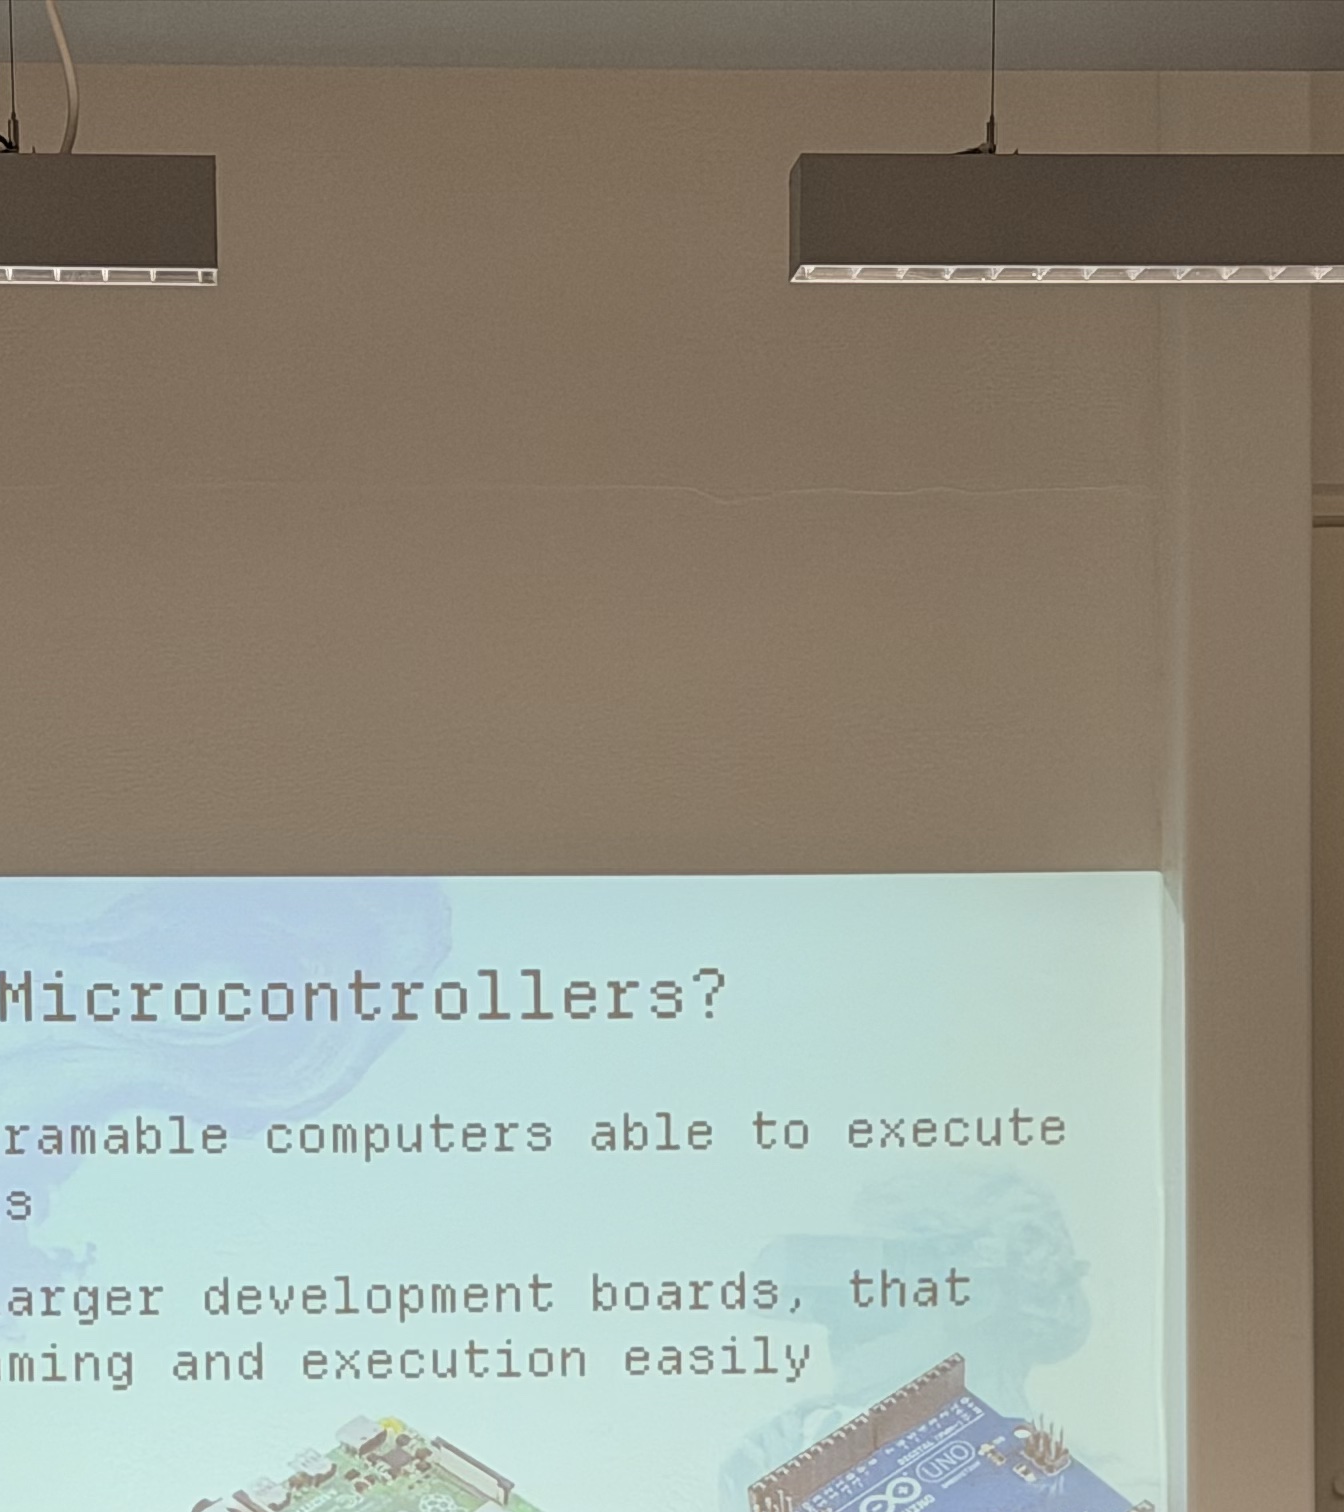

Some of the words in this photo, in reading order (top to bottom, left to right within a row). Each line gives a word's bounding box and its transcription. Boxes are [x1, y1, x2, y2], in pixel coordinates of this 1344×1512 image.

[266, 1112, 553, 1162] computers
[591, 1112, 713, 1152] able
[752, 1111, 811, 1151] to
[847, 1107, 1067, 1148] execute
[203, 1273, 555, 1323] development
[592, 1270, 804, 1314] boards,
[849, 1267, 973, 1309] that
[172, 1342, 265, 1382] and
[302, 1339, 587, 1380] execution
[624, 1336, 813, 1383] easily
[922, 1444, 969, 1479] UNO
